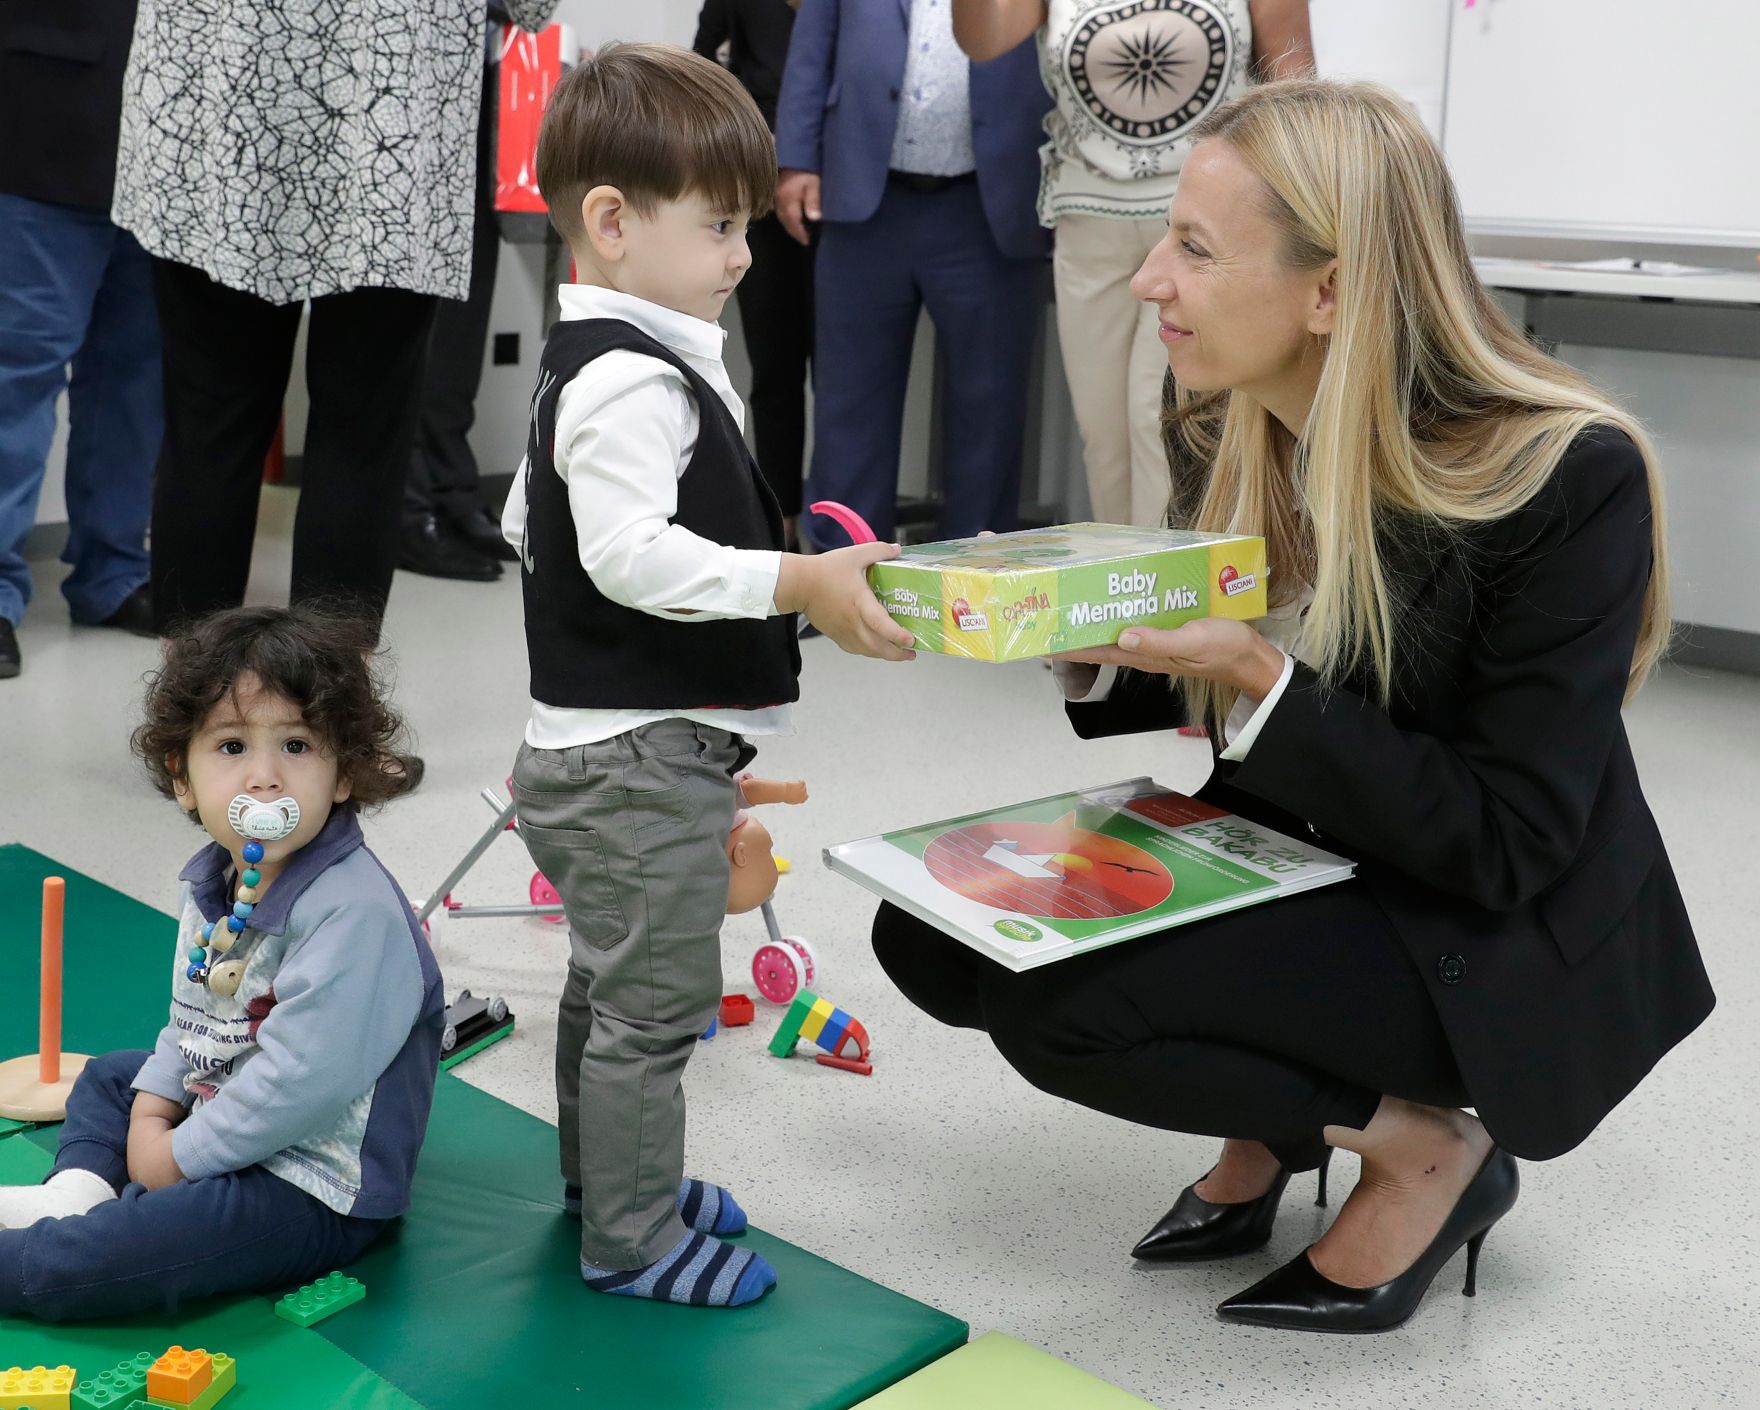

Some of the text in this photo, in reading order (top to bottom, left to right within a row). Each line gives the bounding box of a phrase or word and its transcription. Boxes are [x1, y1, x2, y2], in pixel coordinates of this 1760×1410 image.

[1108, 568, 1157, 596] Baby
[1228, 578, 1255, 592] LISCIANI
[894, 588, 919, 607] Baby
[1071, 585, 1199, 625] Memoria Mix
[922, 605, 940, 620] Mix
[1180, 827, 1298, 874] BAKABU
[193, 1023, 209, 1036] FOR
